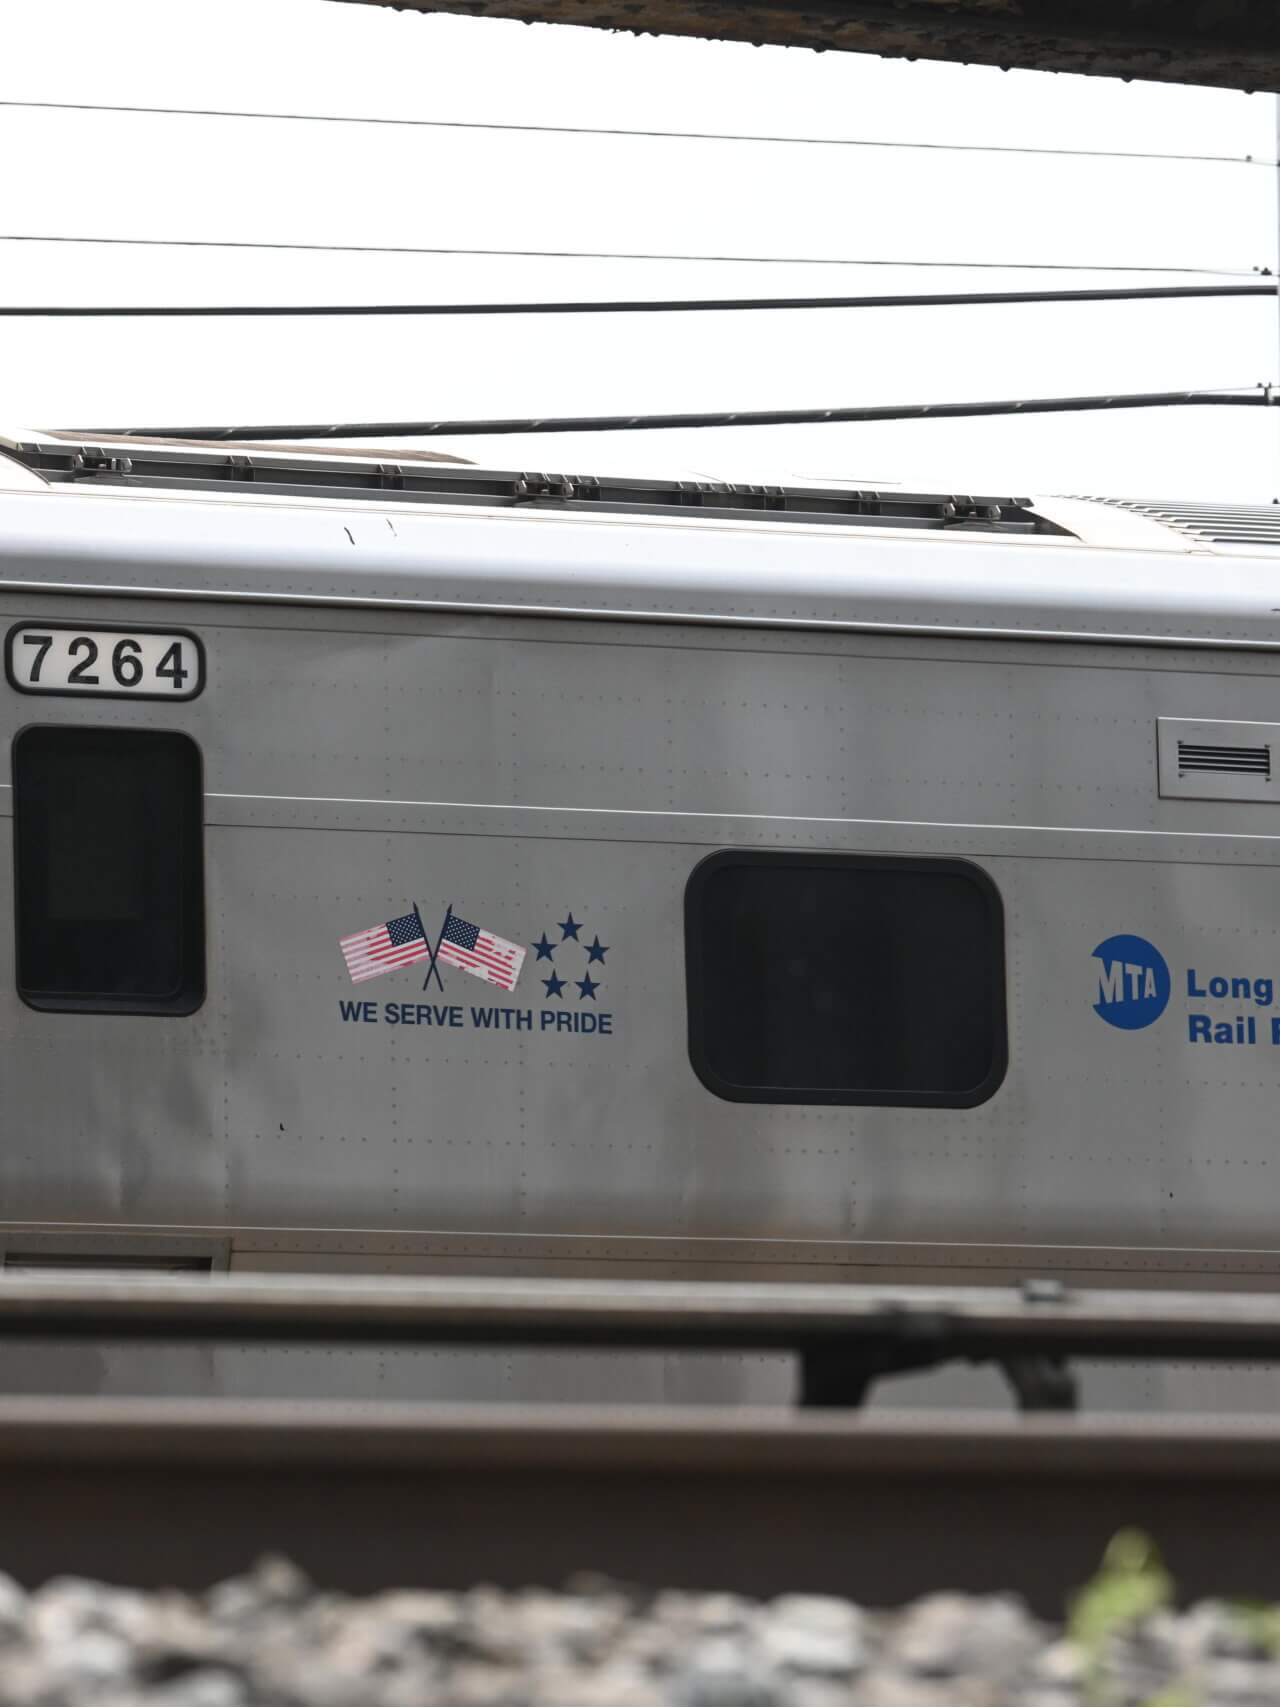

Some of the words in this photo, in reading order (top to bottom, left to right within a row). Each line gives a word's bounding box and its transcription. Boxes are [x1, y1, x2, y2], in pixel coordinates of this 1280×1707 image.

[22, 634, 189, 690] 7264
[1091, 956, 1157, 1005] MTA
[1187, 968, 1274, 1006] Long
[338, 1000, 378, 1023] WE
[384, 1003, 464, 1028] SERVE
[470, 1006, 533, 1031] WITH
[540, 1010, 613, 1035] PRIDE
[1188, 1014, 1257, 1045] Rail
